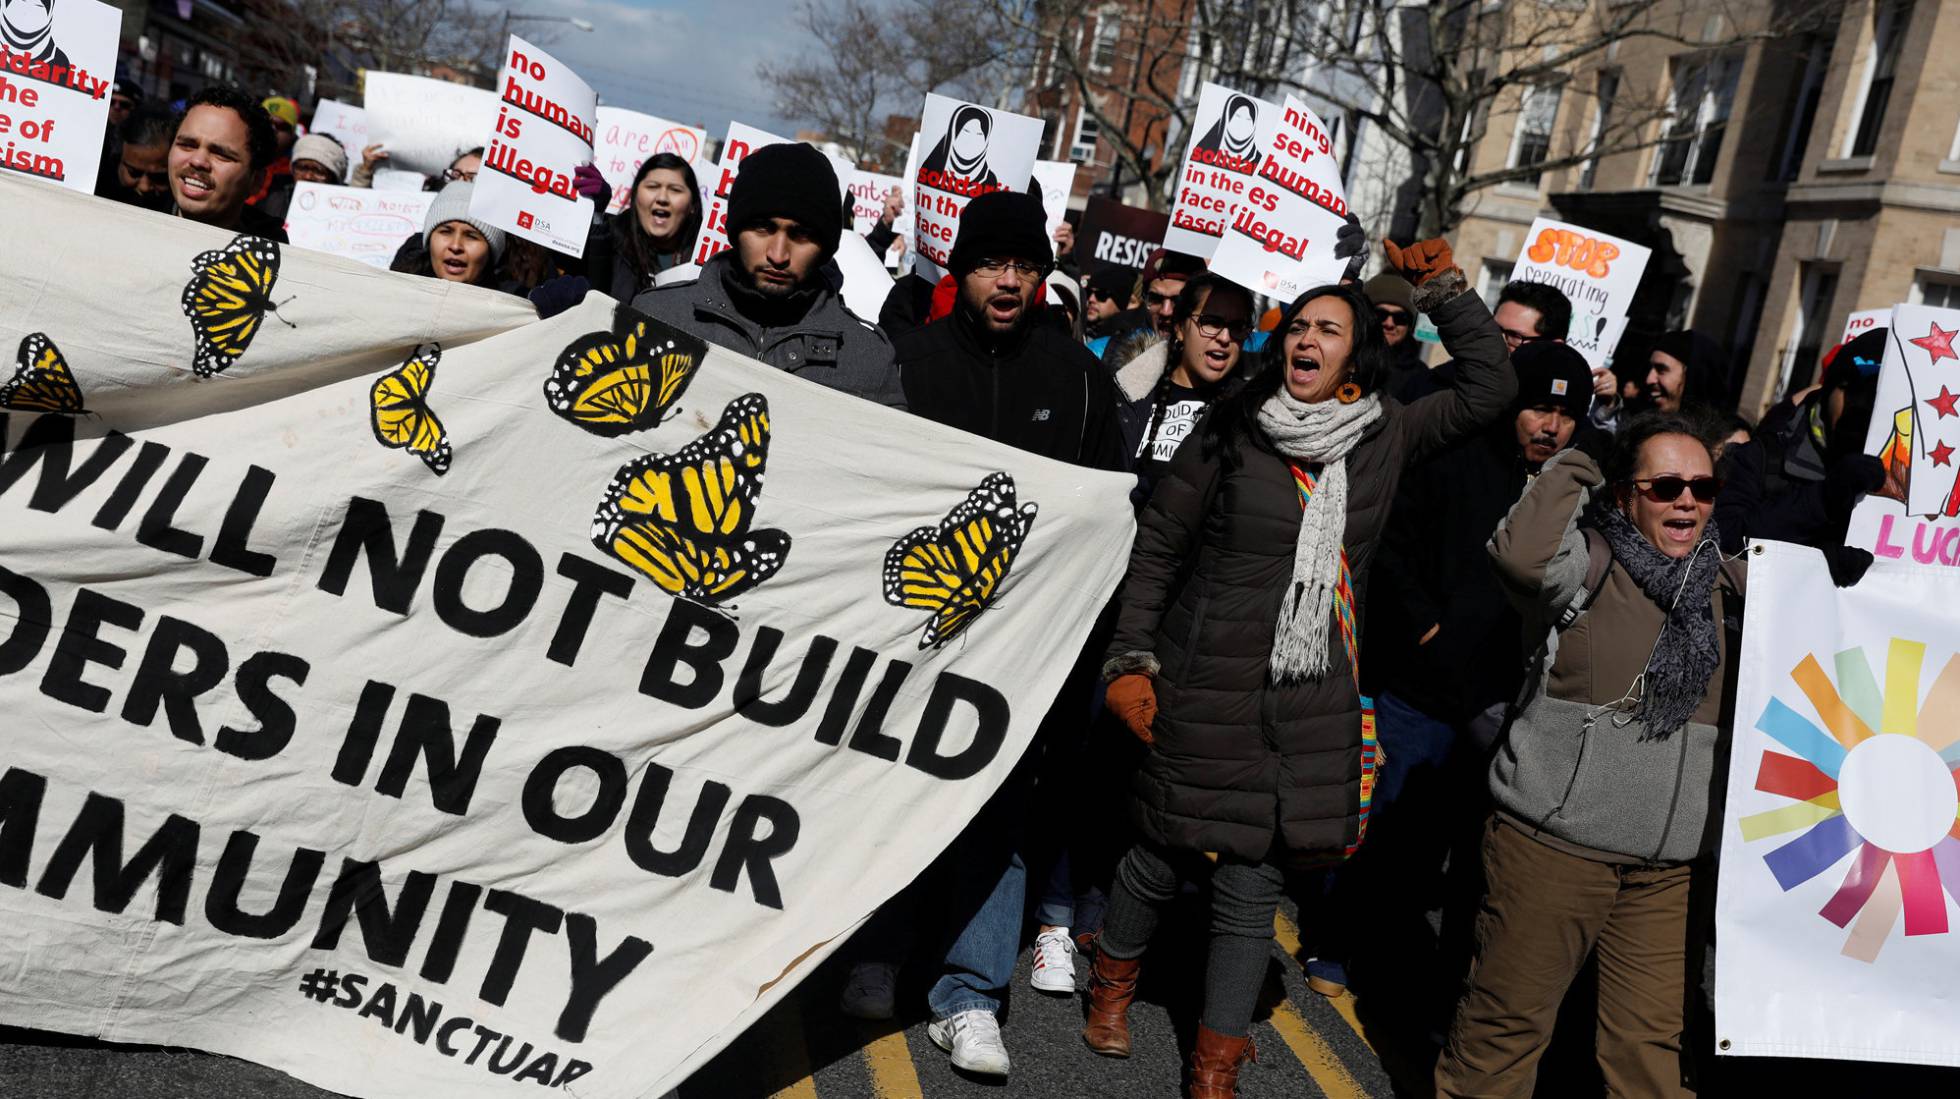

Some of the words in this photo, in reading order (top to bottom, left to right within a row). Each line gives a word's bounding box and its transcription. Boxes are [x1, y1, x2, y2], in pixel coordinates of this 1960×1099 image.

[511, 50, 546, 81] no
[496, 107, 522, 139] is
[504, 76, 594, 146] human
[20, 119, 55, 143] of
[606, 125, 649, 153] are
[0, 141, 64, 178] ism
[1190, 146, 1257, 175] solida
[1273, 132, 1314, 163] ser
[1186, 164, 1205, 185] in
[1210, 171, 1244, 194] the
[1260, 154, 1347, 217] human
[916, 186, 931, 210] in
[937, 195, 966, 218] th
[1181, 187, 1225, 213] face
[1248, 185, 1279, 212] es
[916, 211, 952, 242] face
[1232, 207, 1309, 261] ilegal
[1528, 228, 1620, 278] STOP
[1849, 317, 1874, 328] no
[1166, 424, 1187, 436] OF
[316, 496, 636, 667] NOT
[639, 596, 1010, 781] BUILD
[331, 680, 501, 816] IN
[522, 746, 800, 910] OUR
